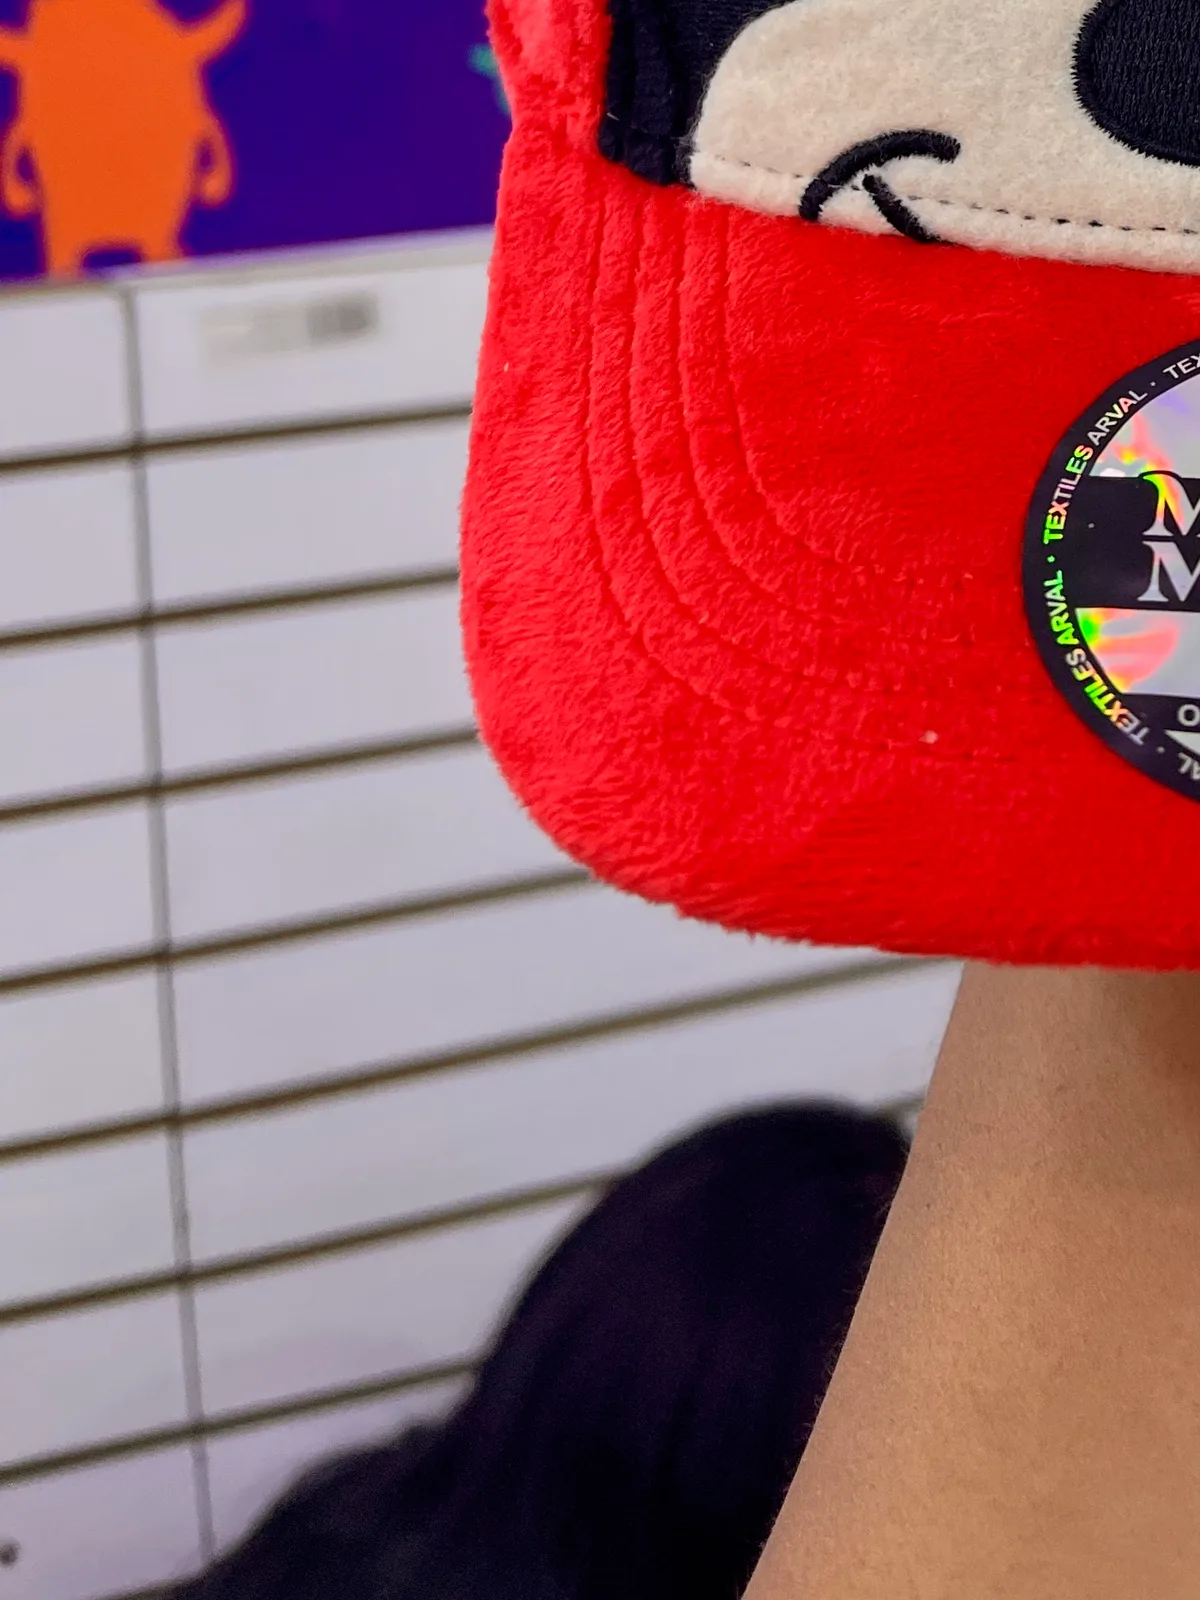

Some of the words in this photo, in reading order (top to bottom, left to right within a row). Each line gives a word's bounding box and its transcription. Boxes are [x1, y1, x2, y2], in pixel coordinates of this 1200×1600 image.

[1042, 444, 1095, 546] TEXTILES
[1086, 388, 1148, 447] ARVAL
[1043, 569, 1080, 646] ARVAL
[1065, 647, 1152, 746] TEXTILES
